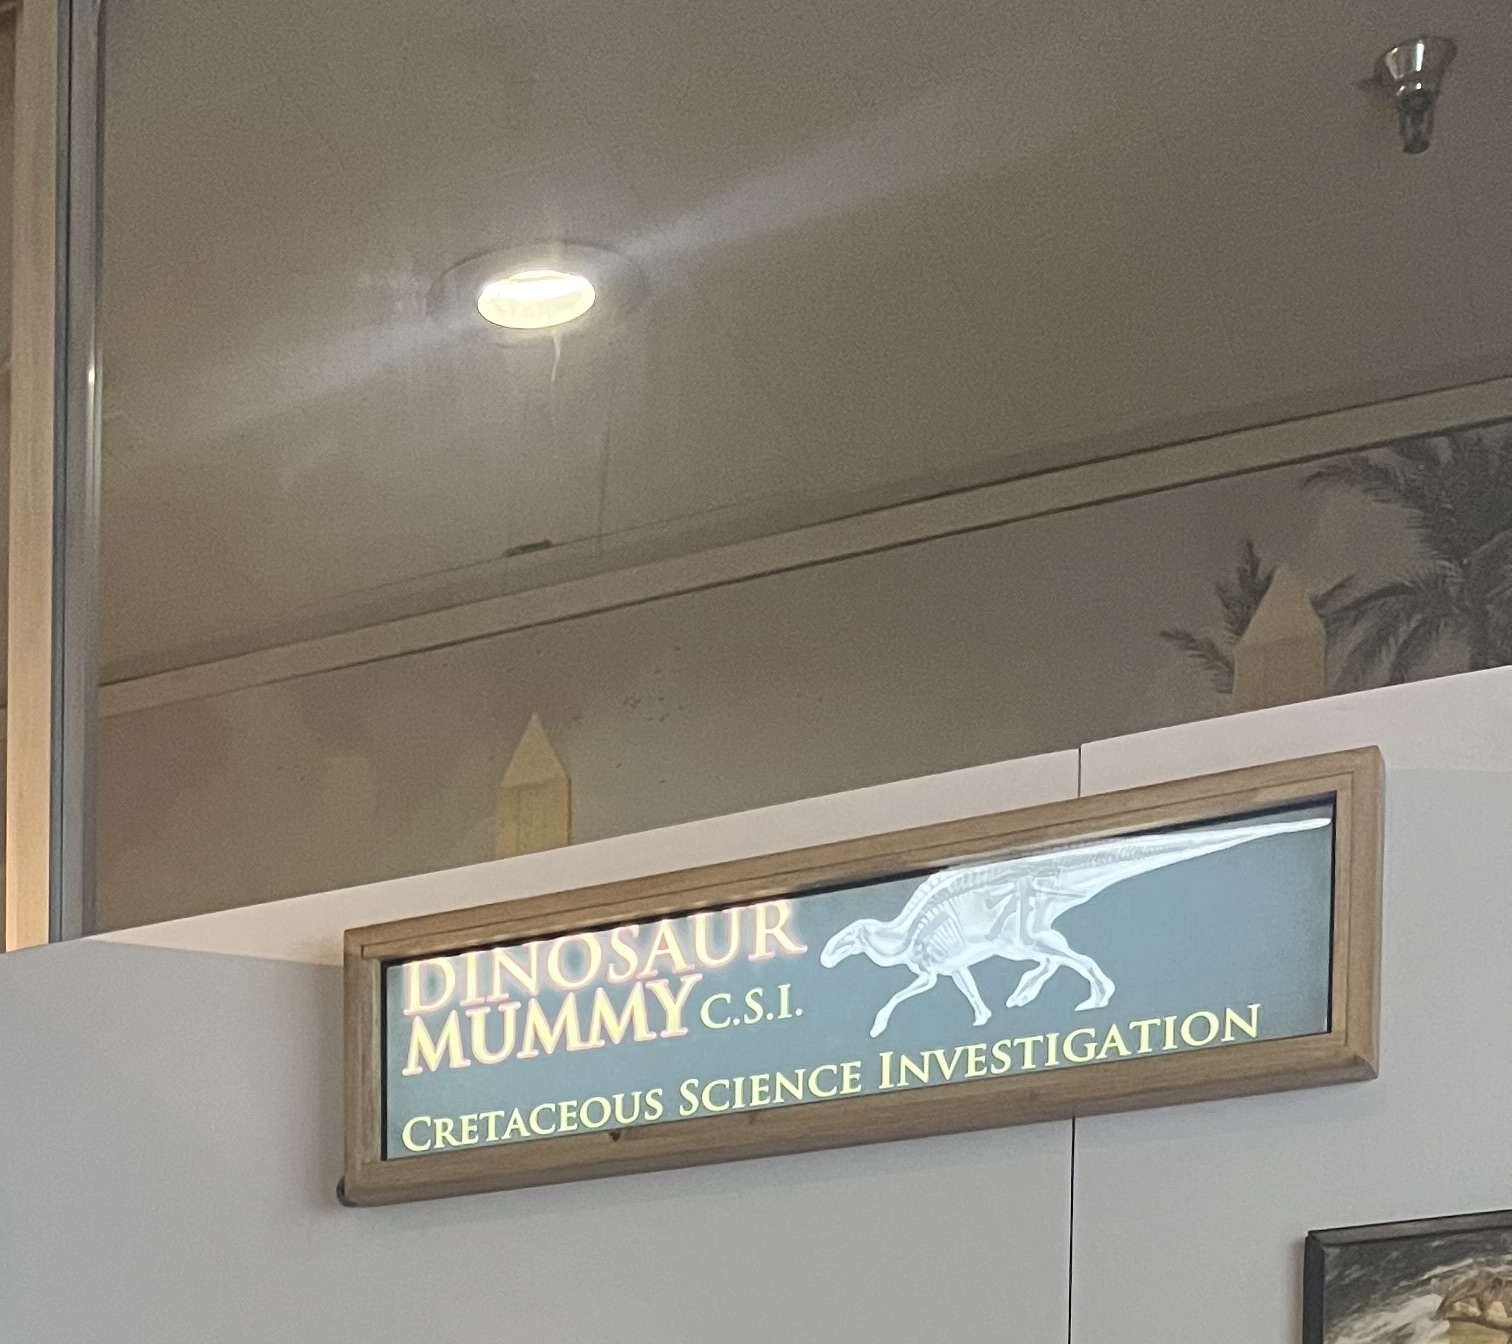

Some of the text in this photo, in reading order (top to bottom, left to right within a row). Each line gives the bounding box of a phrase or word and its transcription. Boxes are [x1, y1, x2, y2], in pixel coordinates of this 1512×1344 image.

[402, 899, 808, 1017] DINOSAUR
[401, 973, 803, 1077] MUMMY C.S.I.
[401, 1004, 1262, 1153] CRETACEOUS SCIENCE INVESTIGATION
